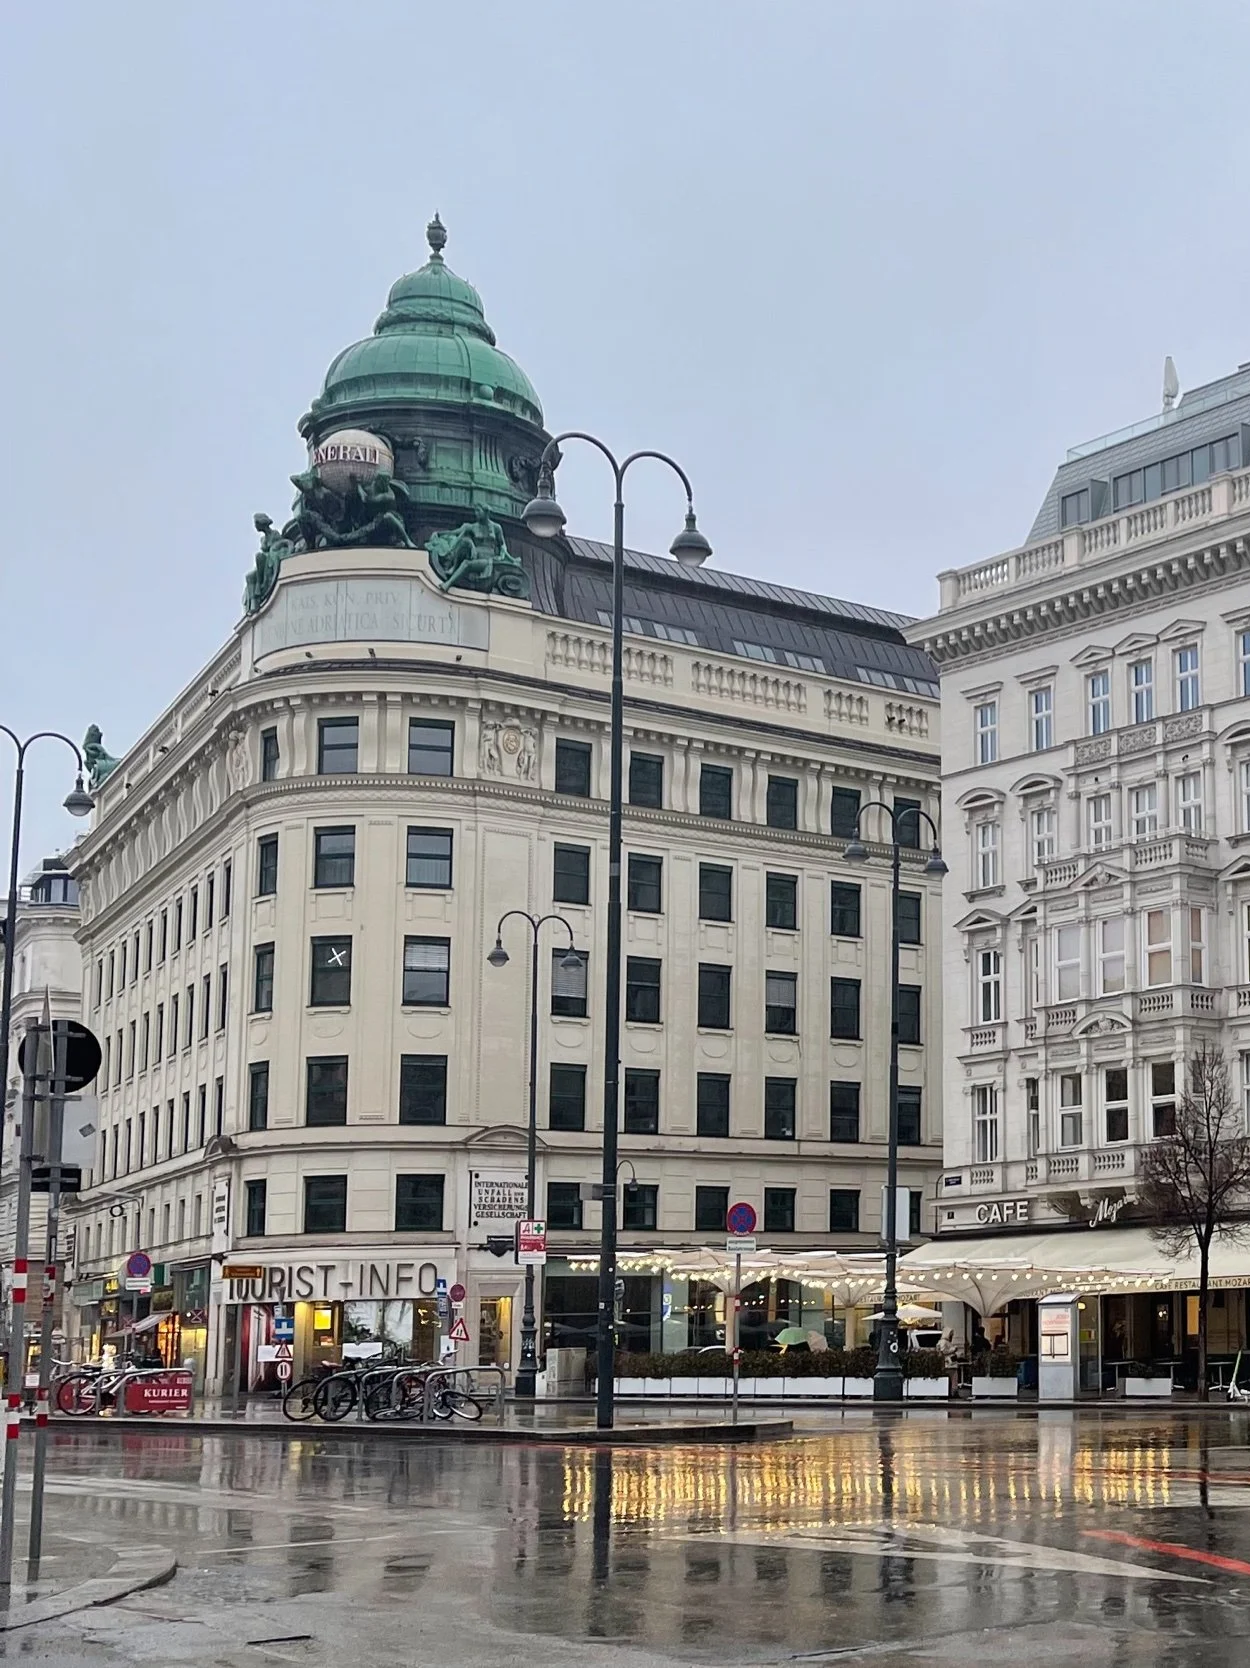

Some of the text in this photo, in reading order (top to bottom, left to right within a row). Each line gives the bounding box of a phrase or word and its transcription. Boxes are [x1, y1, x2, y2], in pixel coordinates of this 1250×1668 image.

[474, 1181, 528, 1189] INTERNATIONALE
[475, 1211, 527, 1219] GESELLSCHAFT
[975, 1200, 1029, 1225] CAFE
[1174, 1279, 1223, 1290] RESTAANT
[144, 1388, 188, 1398] KURIER
